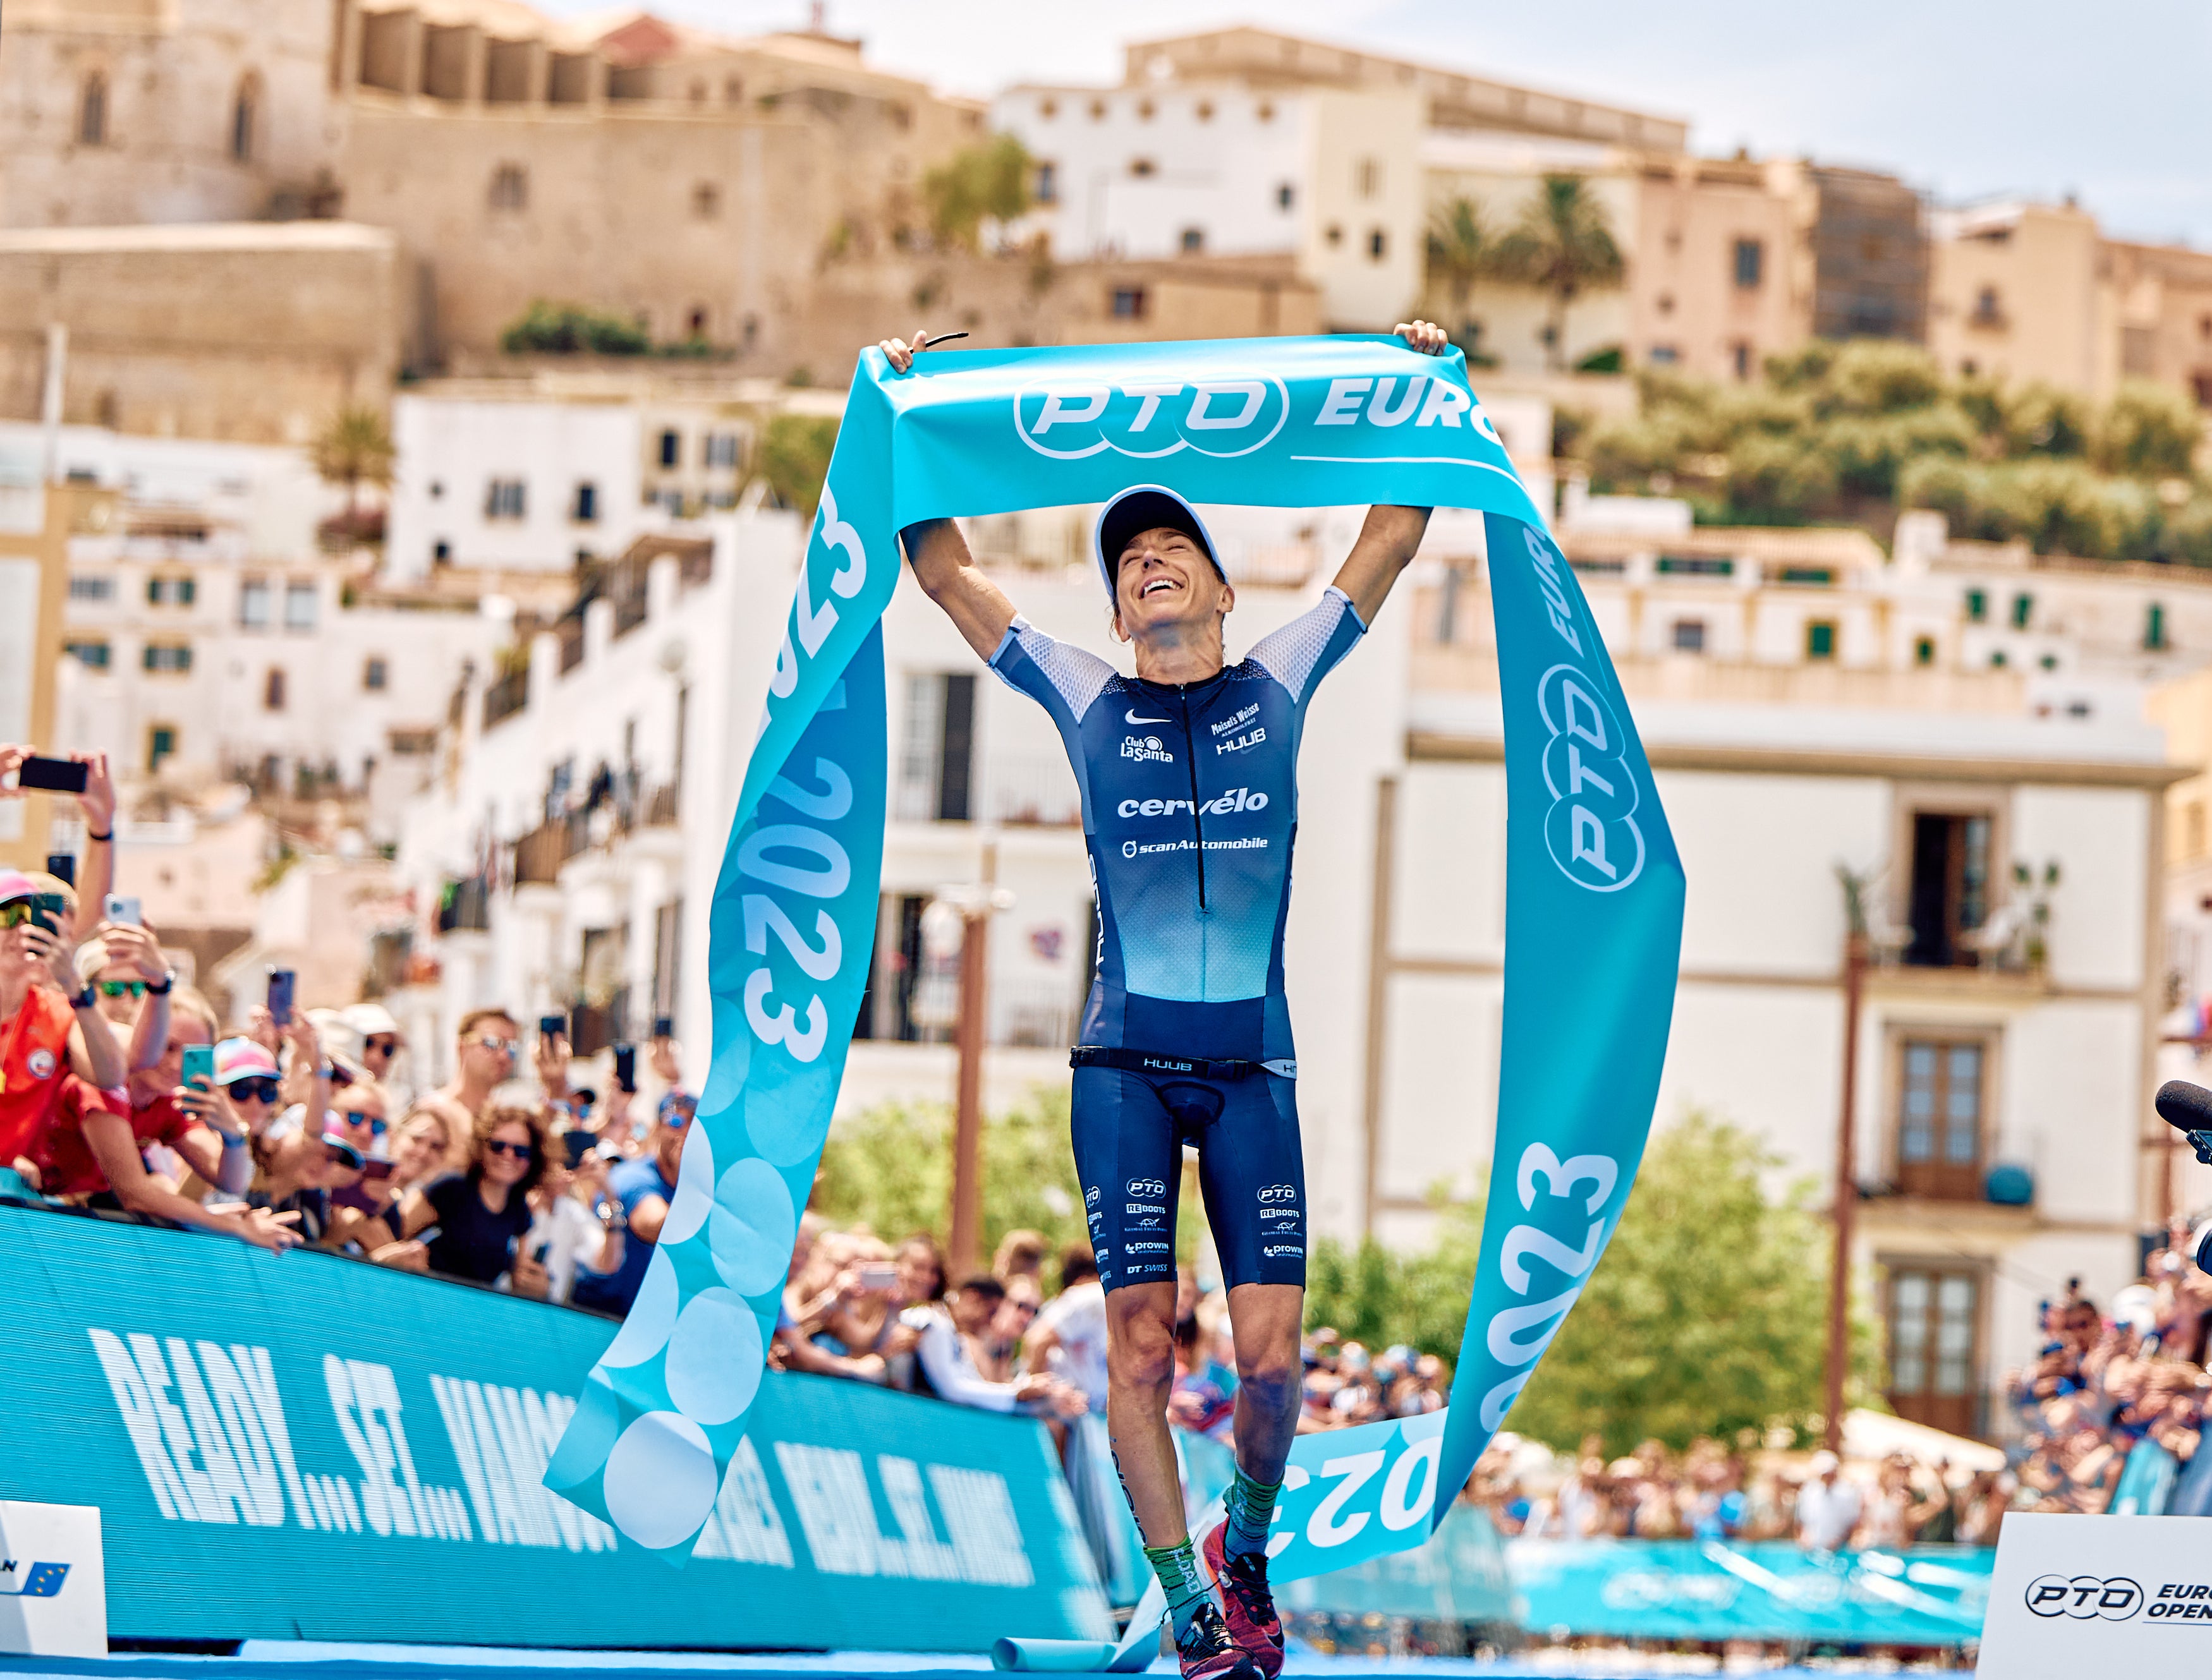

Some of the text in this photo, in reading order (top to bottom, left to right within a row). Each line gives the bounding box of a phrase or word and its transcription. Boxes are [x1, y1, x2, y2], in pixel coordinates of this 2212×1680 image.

[1031, 381, 1267, 434] PTO
[1523, 524, 1584, 659] EUR
[1211, 703, 1260, 735] Maisel's Weisse
[1125, 735, 1145, 748] Club
[1216, 728, 1266, 755] HUUB
[1117, 787, 1268, 818] cervélo
[1144, 1058, 1192, 1071] HUUB
[1130, 1182, 1164, 1194] PTO
[1261, 1188, 1294, 1199] PTO
[1127, 1264, 1168, 1274] DT SWISS
[2032, 1584, 2212, 1608] PTO EUR
[2148, 1602, 2212, 1619] OPEN
